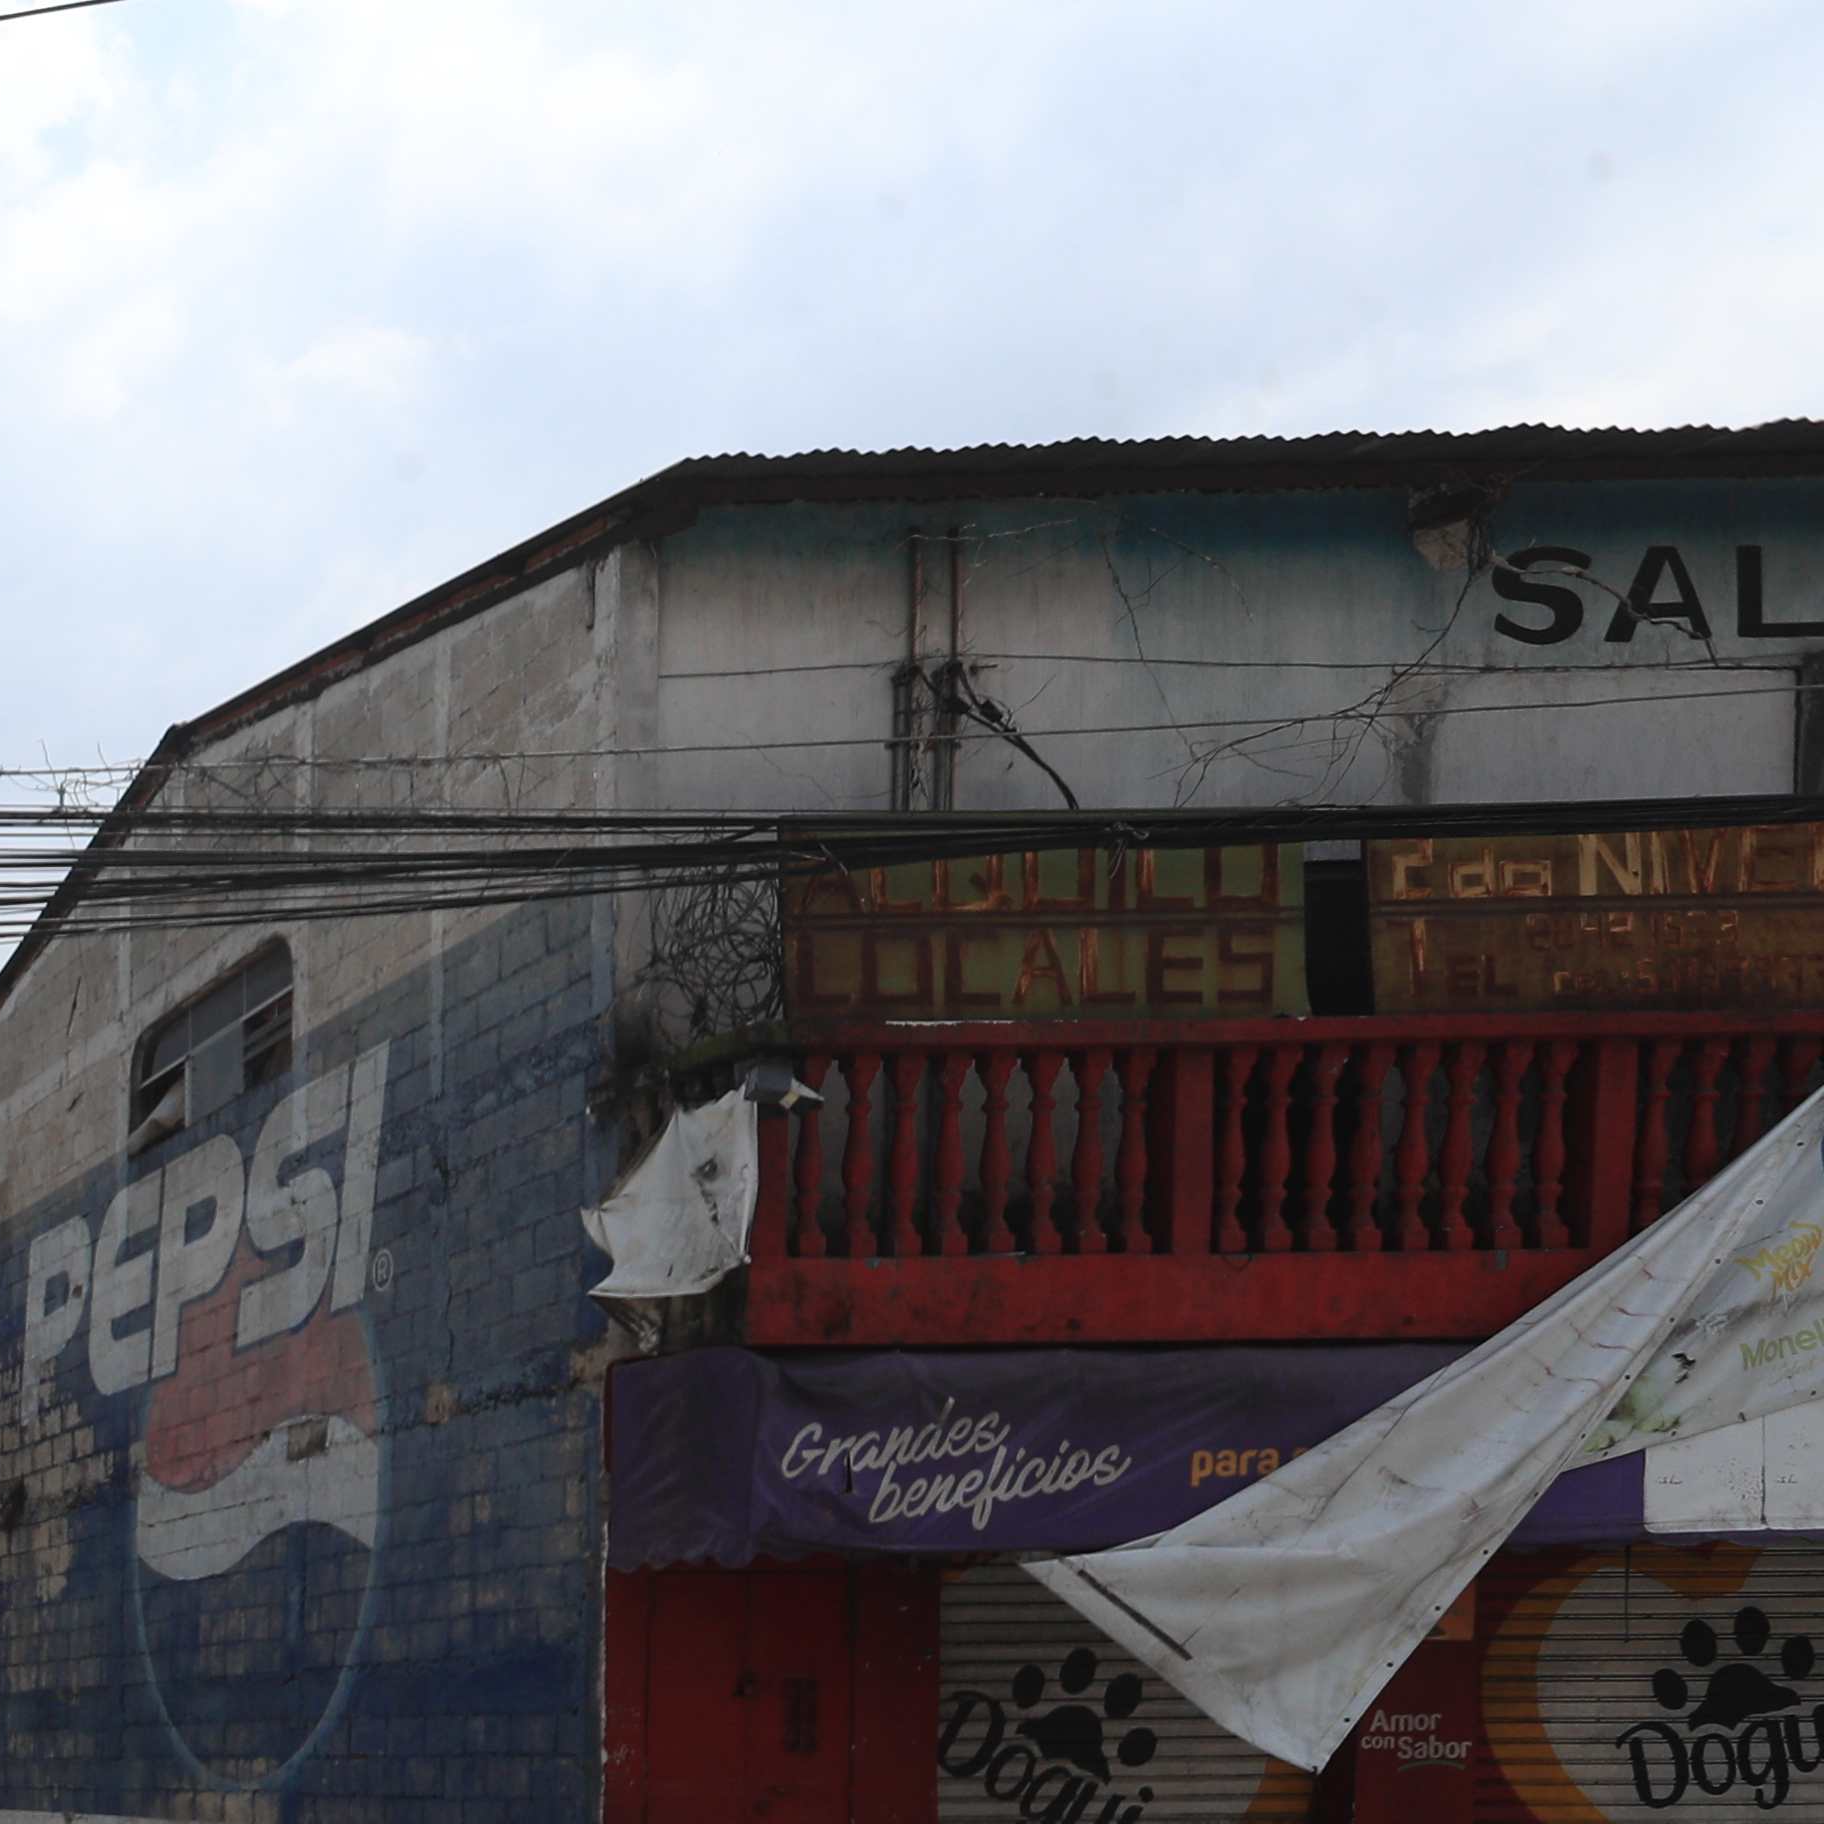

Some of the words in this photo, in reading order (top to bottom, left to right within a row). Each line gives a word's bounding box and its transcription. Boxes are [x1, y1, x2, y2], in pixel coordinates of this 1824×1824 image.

[1492, 545, 1824, 645] SAL
[794, 924, 1276, 1007] LOCALES
[20, 1039, 391, 1426] PEPSI
[780, 1396, 1011, 1479] Grandes
[1189, 1447, 1281, 1488] para
[867, 1440, 1133, 1532] beneficios
[1360, 1734, 1396, 1750] con
[1396, 1734, 1473, 1760] Sabor
[1369, 1709, 1443, 1733] Amor
